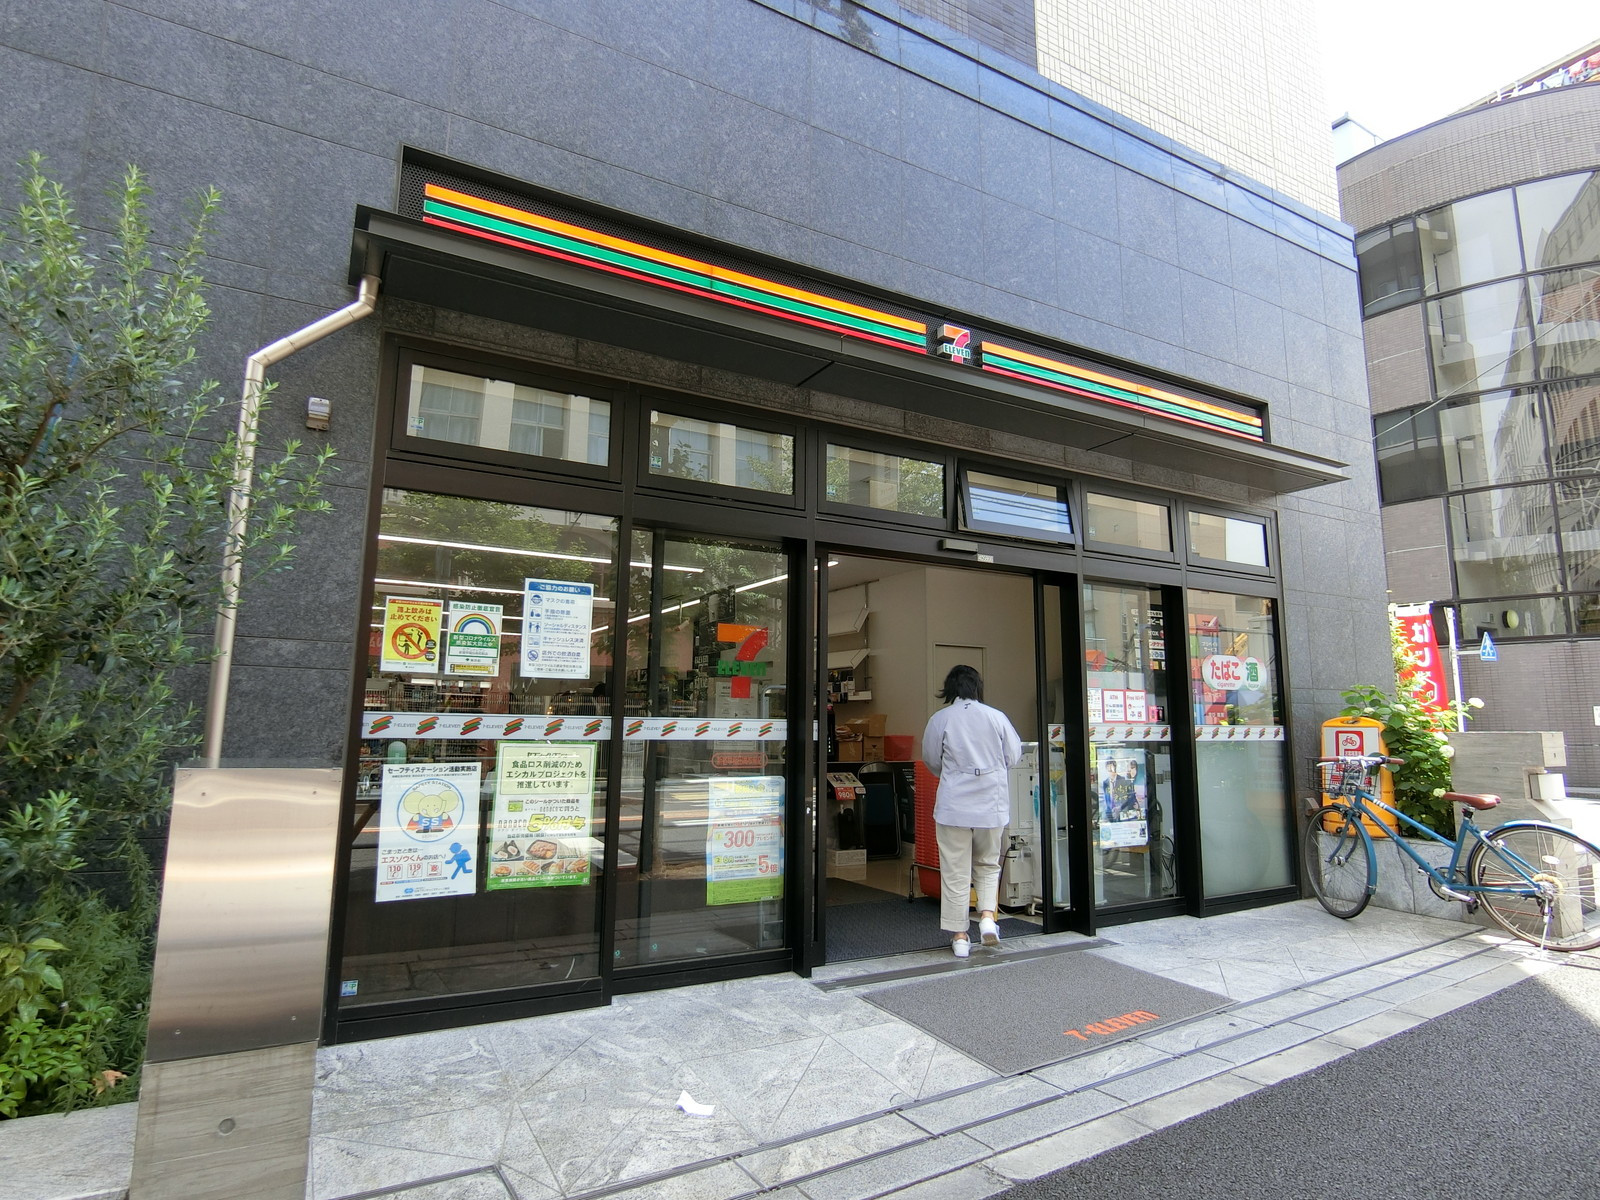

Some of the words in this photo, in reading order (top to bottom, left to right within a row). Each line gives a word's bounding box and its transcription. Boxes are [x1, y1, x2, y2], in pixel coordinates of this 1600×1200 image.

[1210, 660, 1241, 681] たばこ
[1245, 662, 1259, 682] 酒
[511, 760, 583, 769] 食品ロス削減のため
[505, 770, 588, 779] エシカルプロジェクトを
[723, 829, 755, 848] 300
